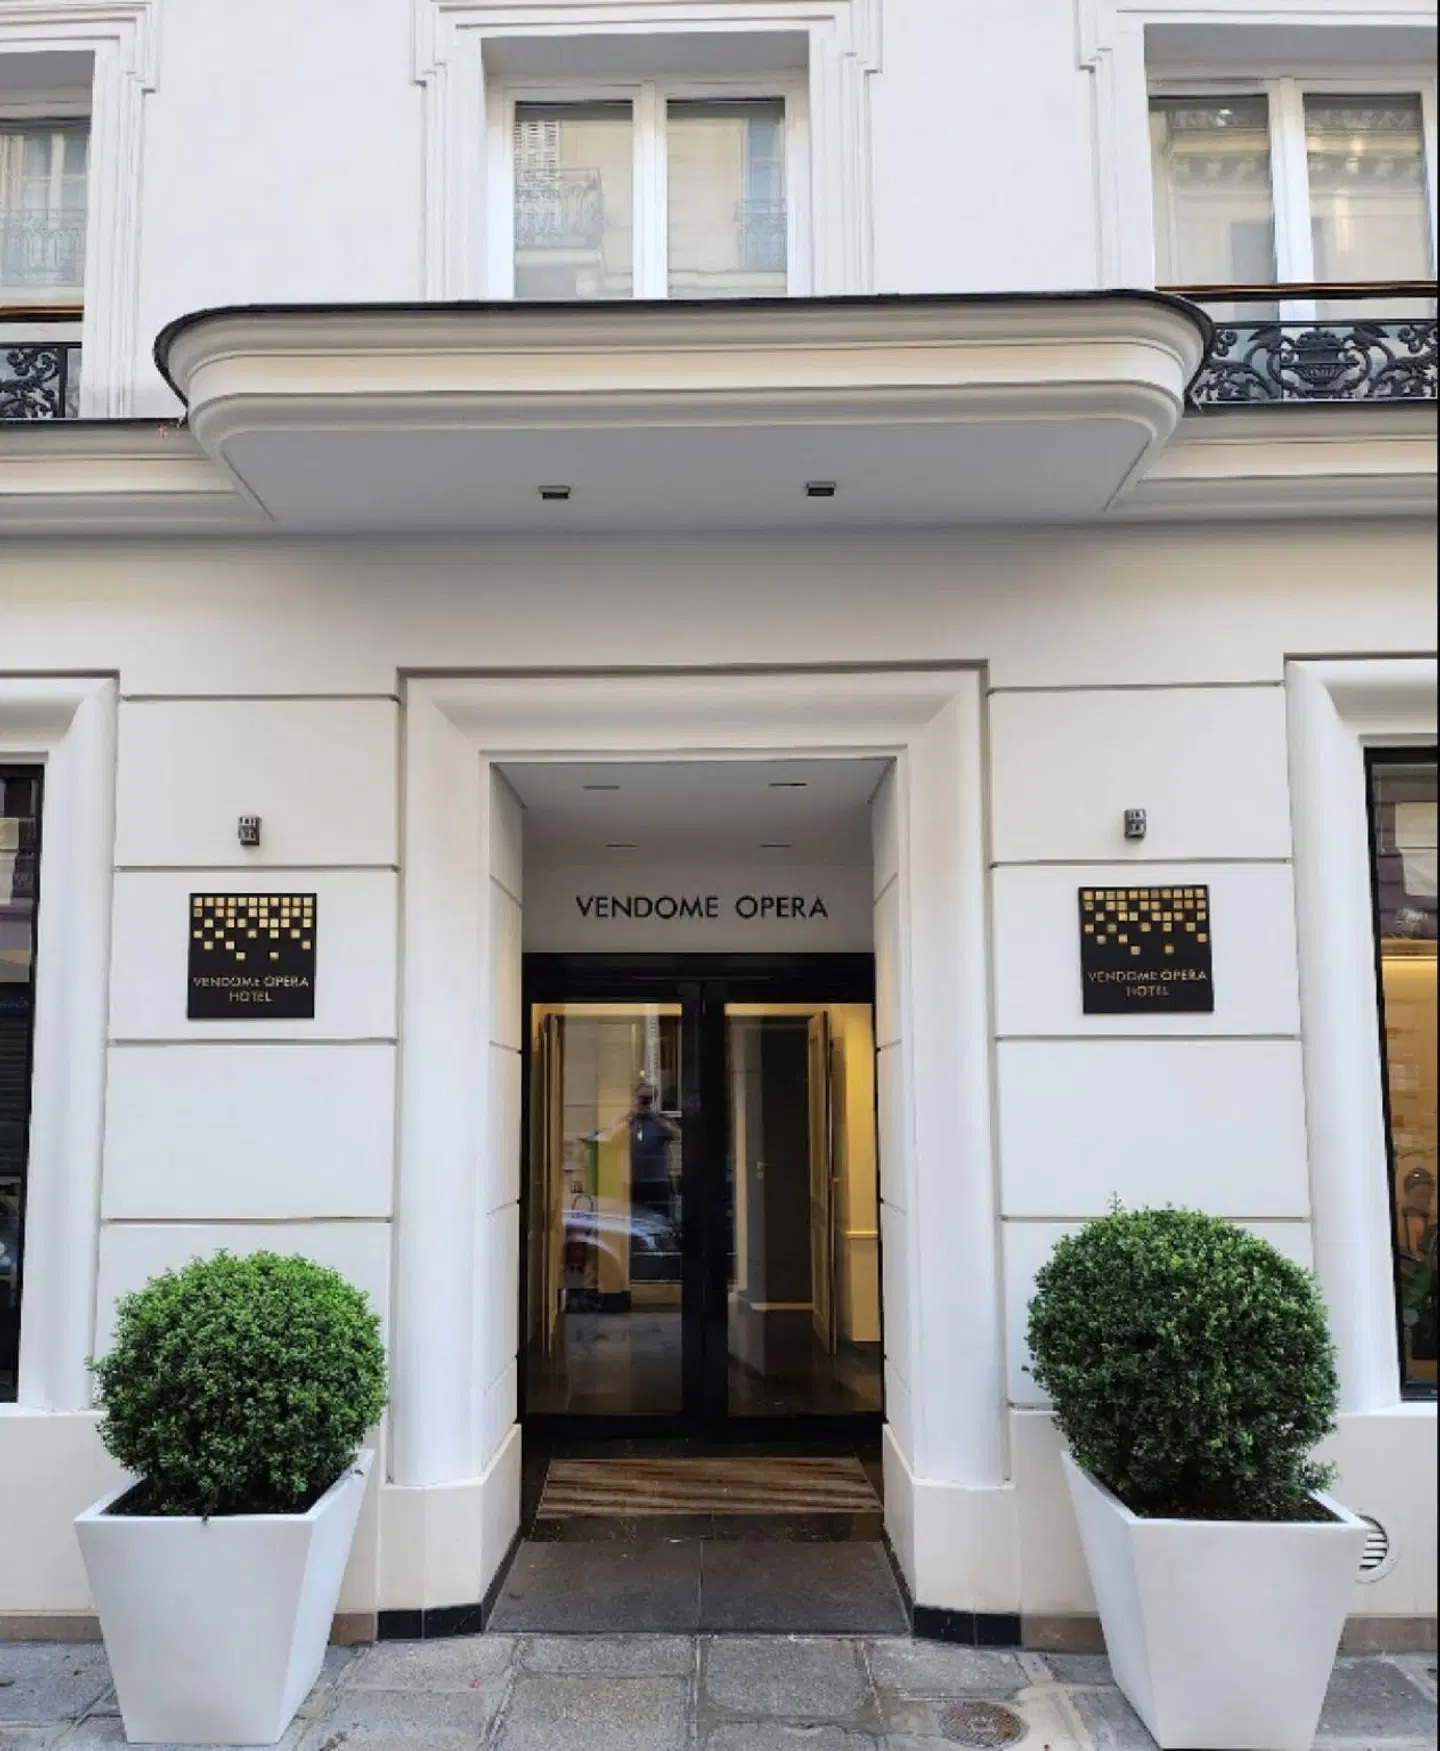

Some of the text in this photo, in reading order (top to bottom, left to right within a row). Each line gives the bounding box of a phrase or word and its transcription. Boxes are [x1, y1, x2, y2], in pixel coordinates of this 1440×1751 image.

[575, 895, 829, 919] VENDOME OPERA
[193, 975, 310, 988] VENDOME OPERA
[1088, 968, 1208, 982] VENDOME OPERA
[229, 990, 273, 1003] HOTEL
[1126, 985, 1170, 997] HOTEL
